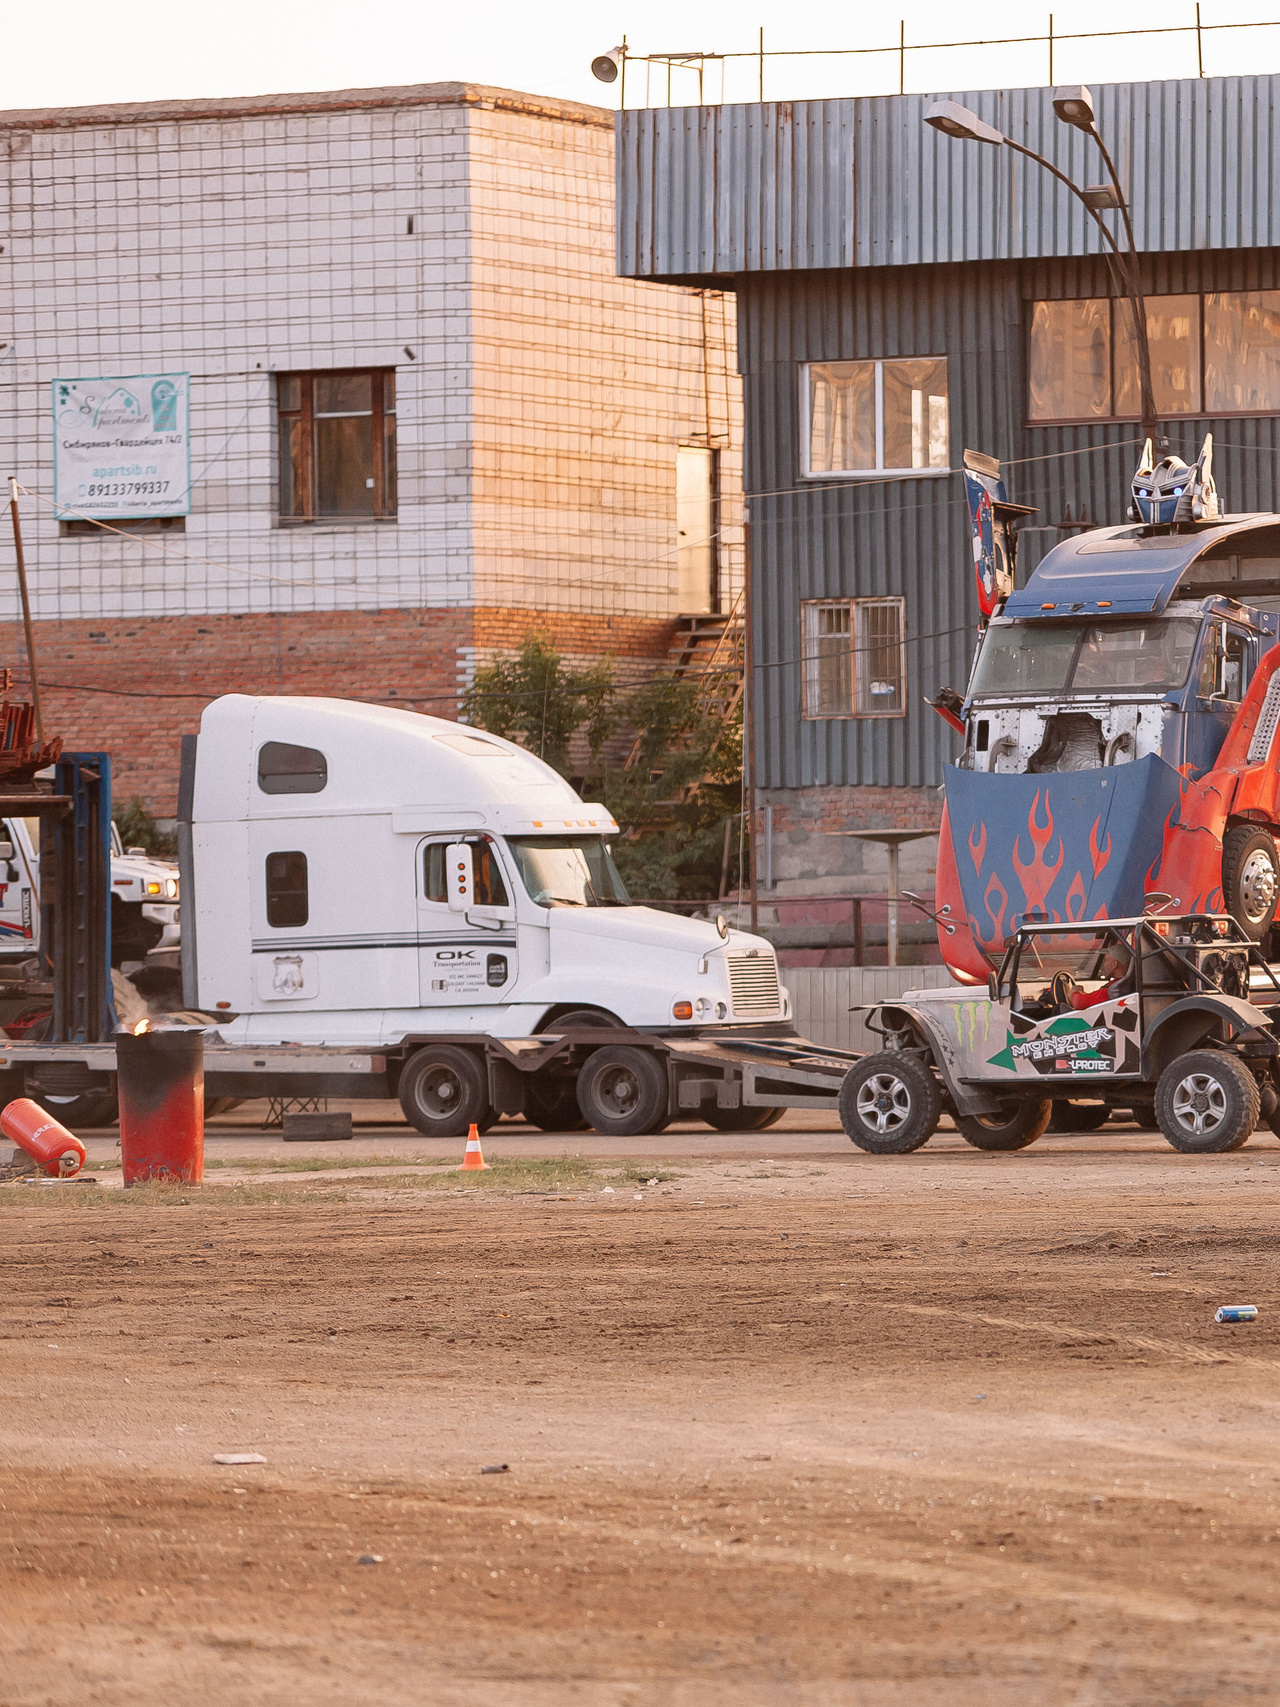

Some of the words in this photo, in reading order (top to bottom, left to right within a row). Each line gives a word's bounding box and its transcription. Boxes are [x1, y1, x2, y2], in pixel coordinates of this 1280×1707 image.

[92, 464, 157, 479] apartsib.ru
[88, 481, 170, 496] 89133799337
[436, 950, 476, 959] OK
[1011, 1027, 1112, 1057] MONSTER
[1033, 1041, 1098, 1059] ENERGY
[1068, 1060, 1111, 1070] UPROTEC
